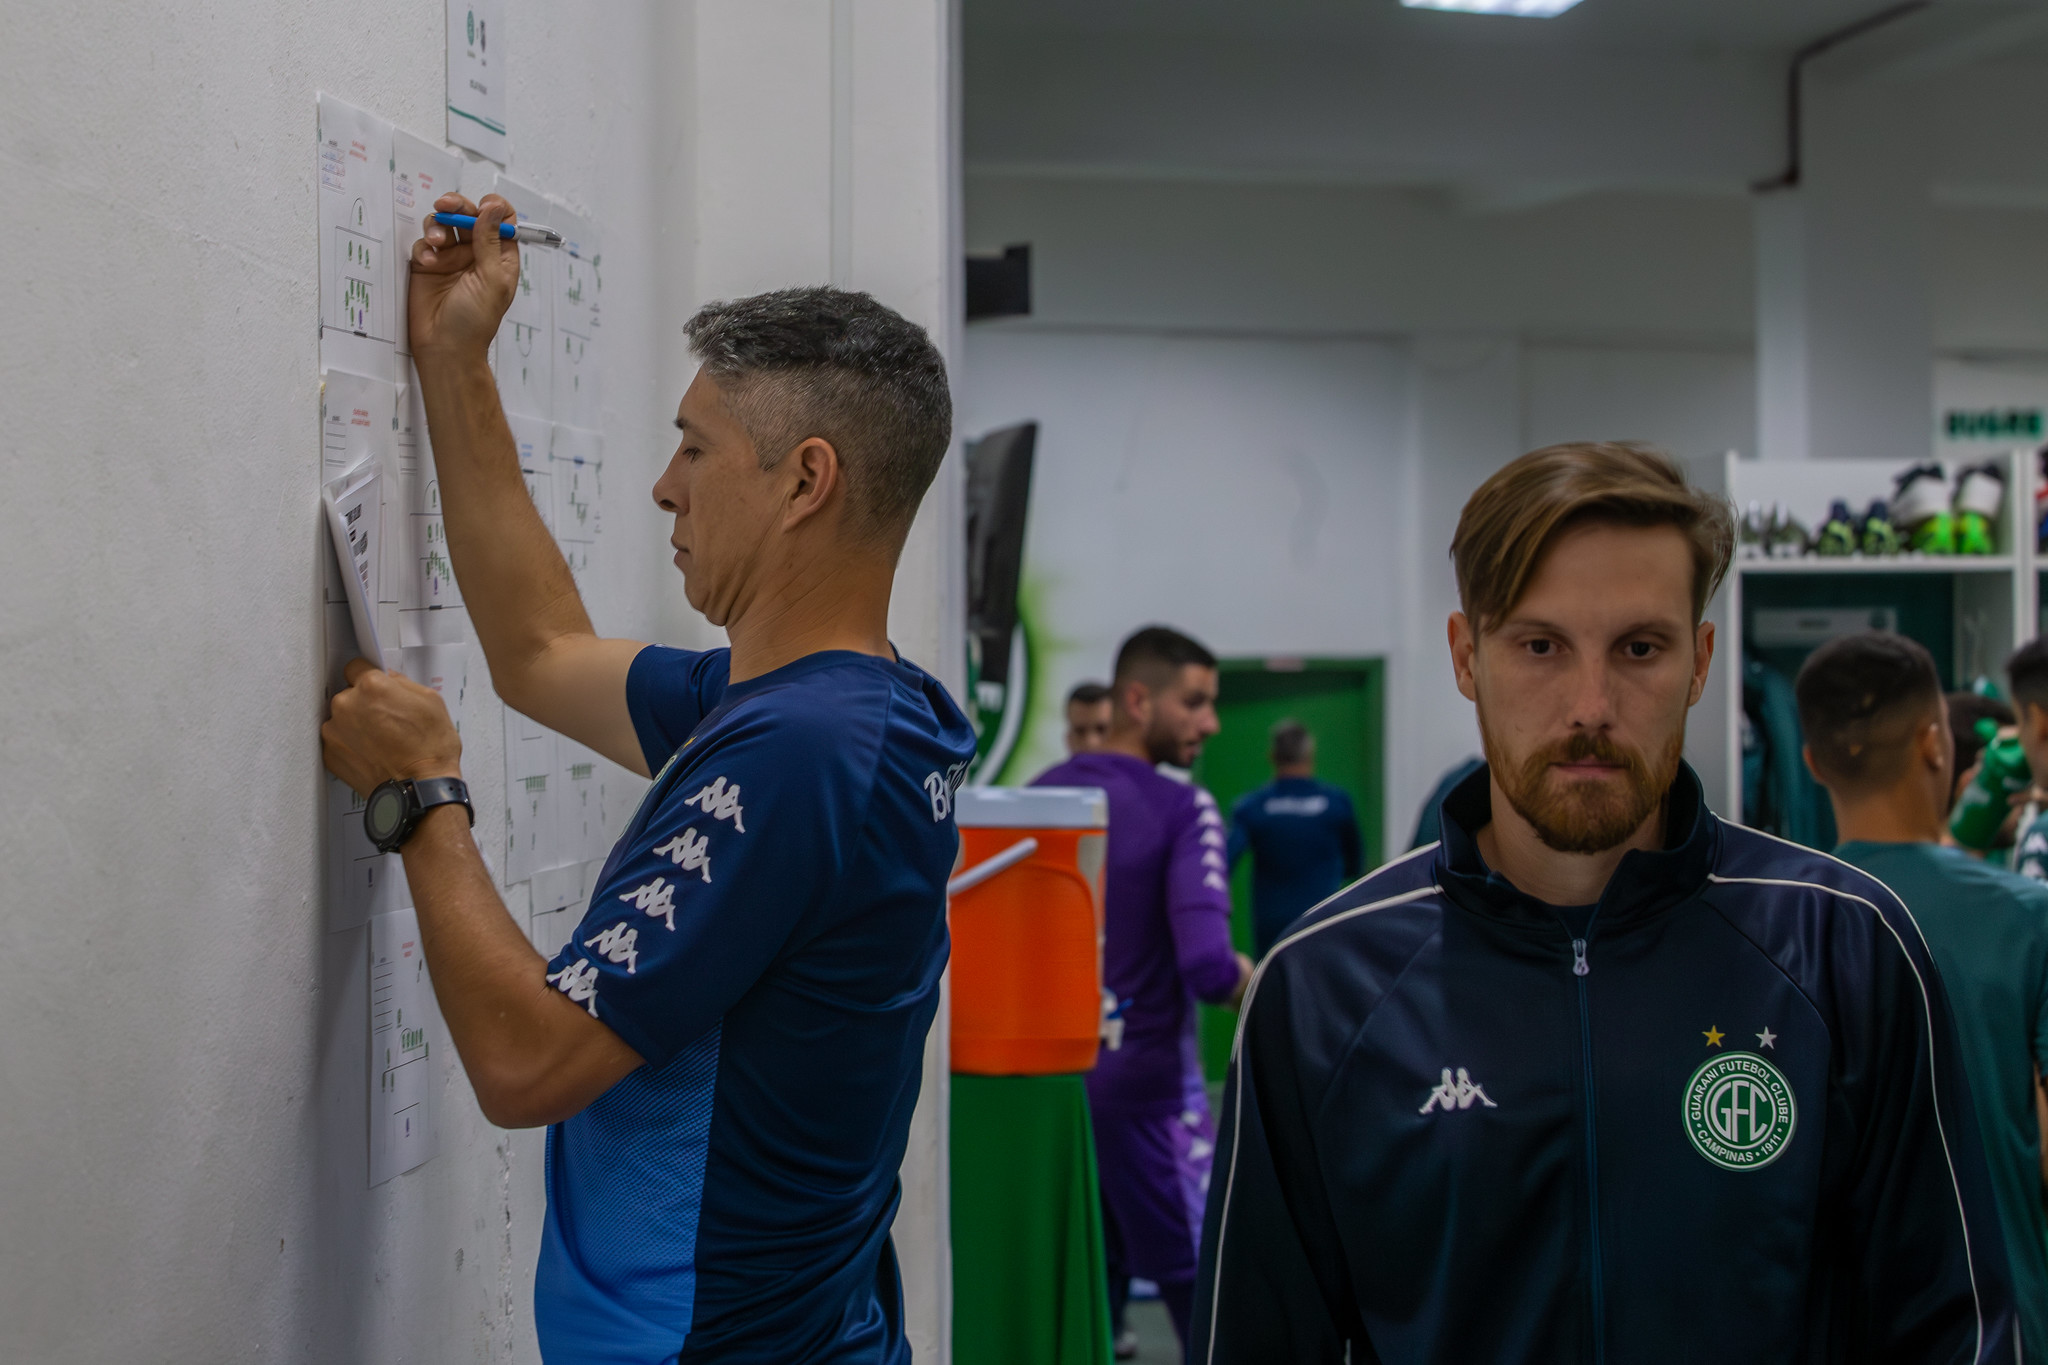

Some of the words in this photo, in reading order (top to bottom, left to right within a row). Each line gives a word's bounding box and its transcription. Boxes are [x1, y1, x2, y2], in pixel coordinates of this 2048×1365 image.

[1691, 1068, 1719, 1121] GUARANI
[1719, 1060, 1772, 1084] FUTEBOL
[1771, 1082, 1789, 1124] CLUBE
[1710, 1080, 1768, 1143] GFC
[1697, 1129, 1754, 1163] CAMPINAS
[1760, 1134, 1783, 1155] 1911
